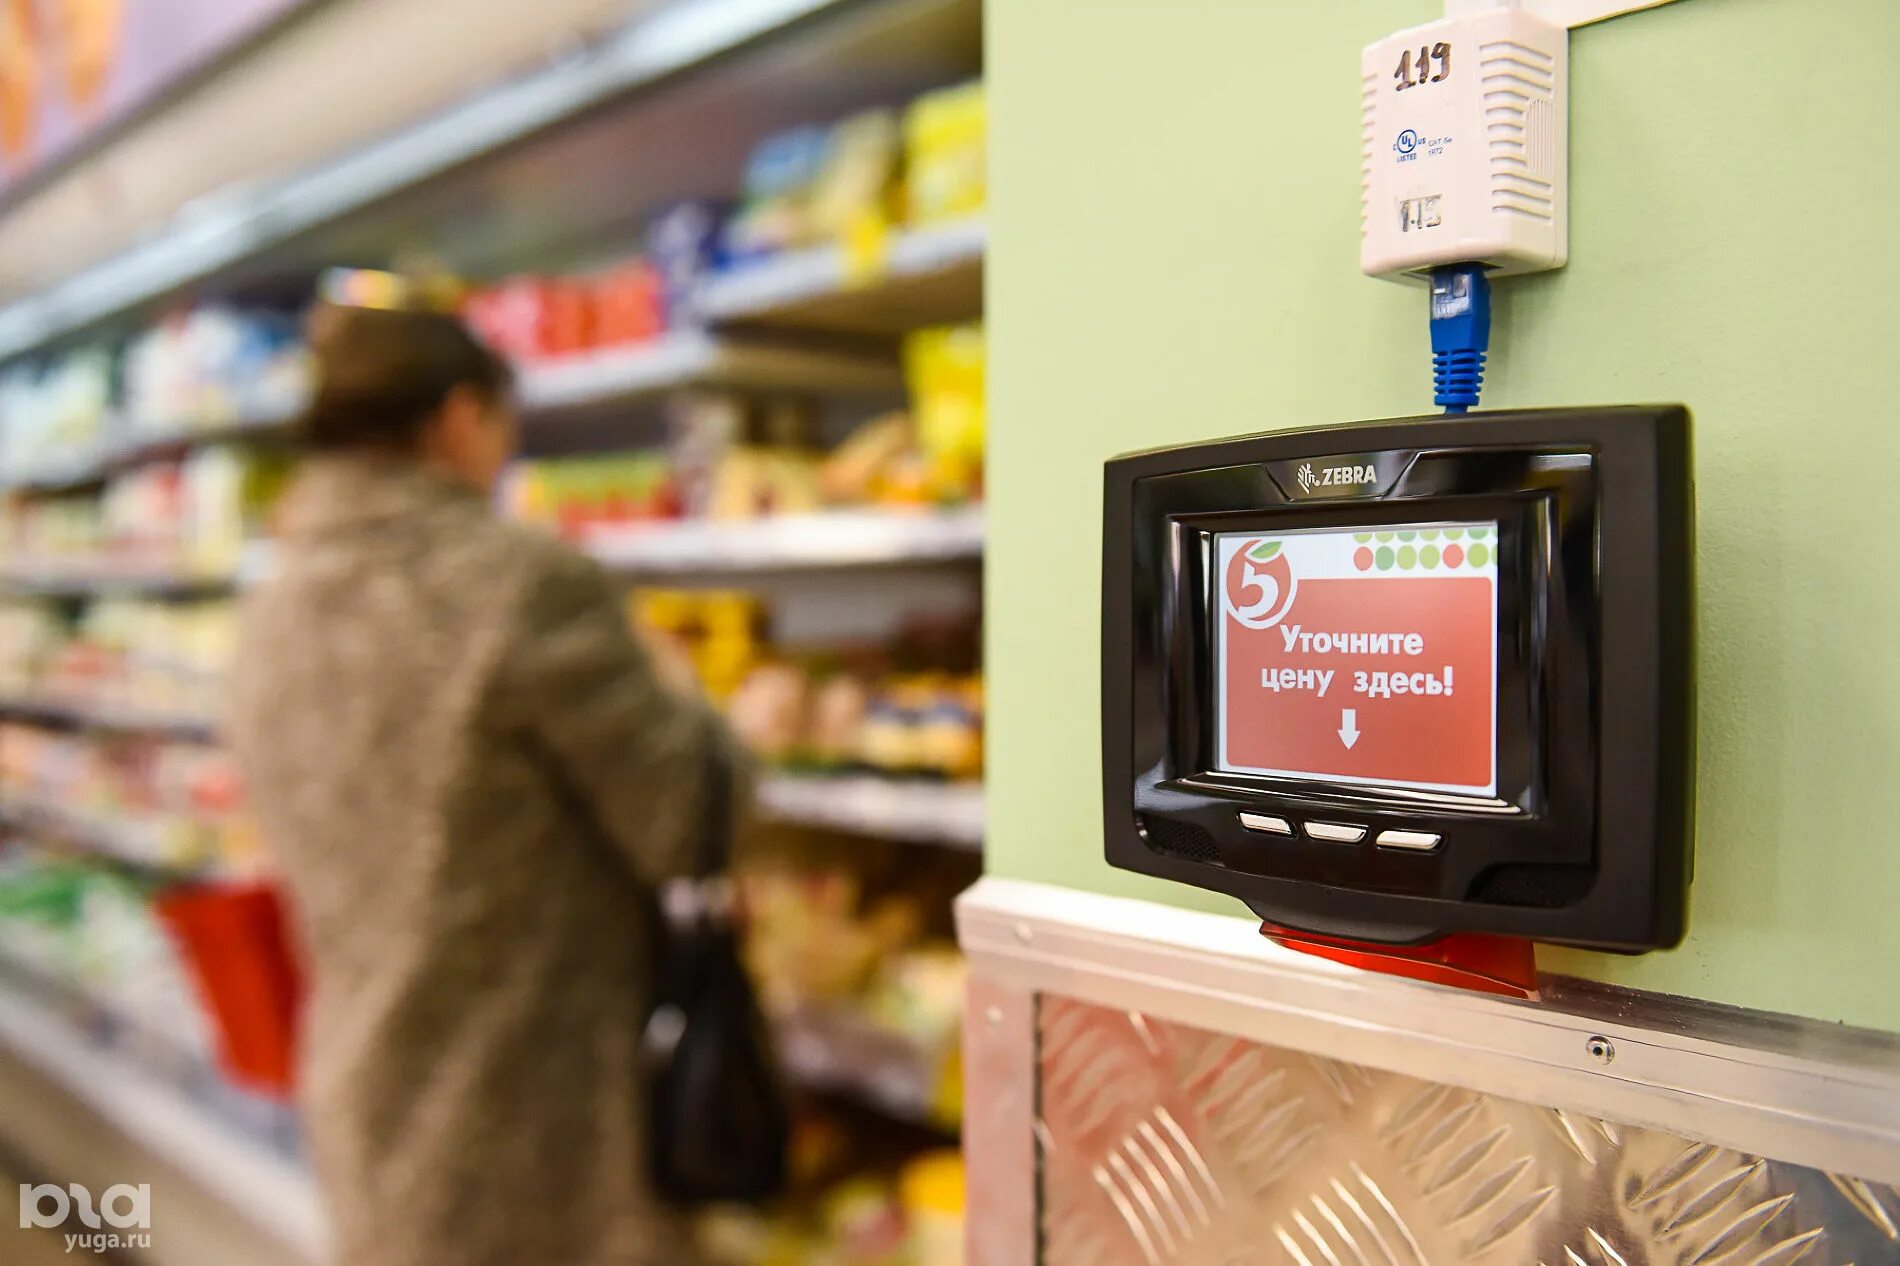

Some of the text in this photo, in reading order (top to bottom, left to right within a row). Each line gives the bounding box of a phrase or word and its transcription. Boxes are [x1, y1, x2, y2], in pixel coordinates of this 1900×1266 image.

[1394, 42, 1451, 91] 119
[1322, 465, 1377, 486] ZEBRA
[1238, 561, 1279, 619] 5
[1280, 624, 1424, 655] Уточните
[1261, 666, 1454, 698] цену здесь!
